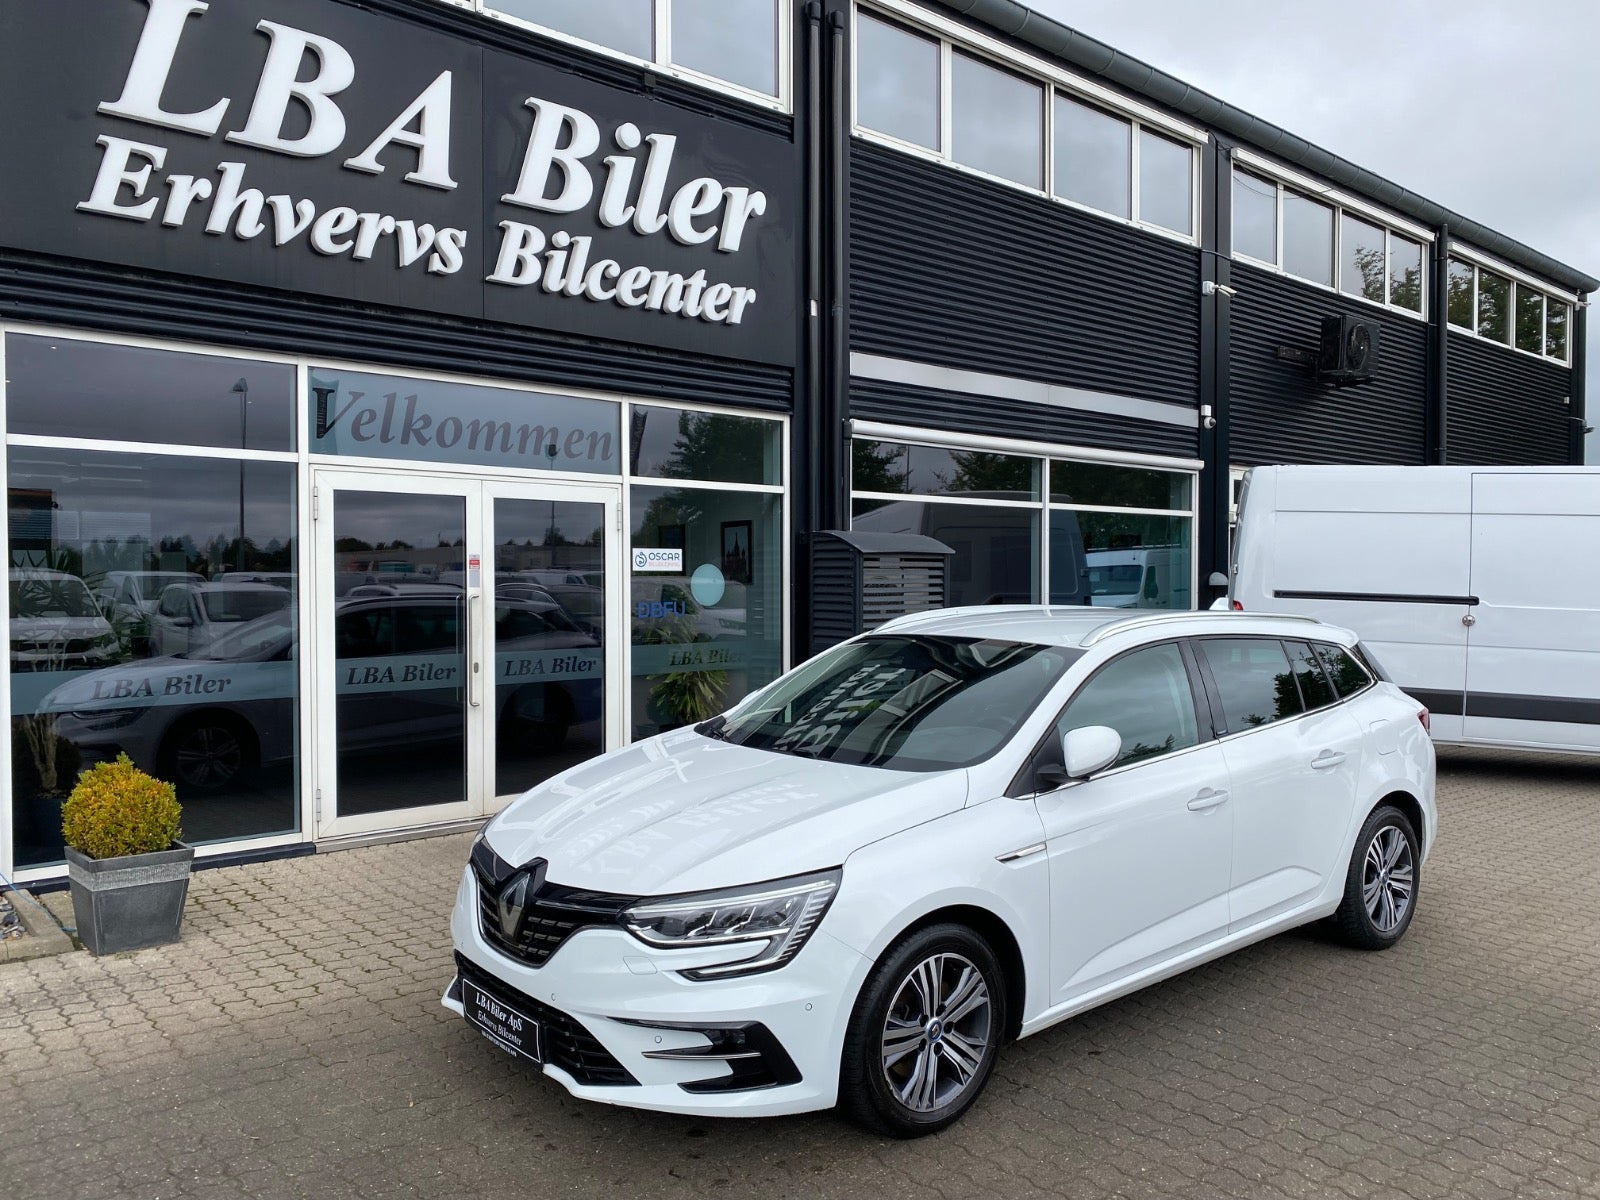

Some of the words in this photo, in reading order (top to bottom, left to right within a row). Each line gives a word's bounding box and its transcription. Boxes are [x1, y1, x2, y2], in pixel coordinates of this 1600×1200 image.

[97, 0, 458, 191] LBA
[500, 96, 767, 254] Biler
[77, 133, 468, 276] Erhvervs
[485, 219, 757, 325] Bilcenter
[311, 386, 614, 462] Velkommen
[648, 552, 680, 561] OSCAR
[504, 659, 546, 677] LBA
[550, 655, 597, 674] Biler
[669, 651, 704, 667] LBA
[90, 677, 154, 701] LBA
[163, 673, 232, 697] Biler
[346, 665, 395, 686] LBA
[401, 662, 457, 683] Biler
[476, 992, 490, 1011] LBA
[490, 1001, 507, 1022] Biler
[507, 1013, 523, 1032] ApS
[498, 1025, 522, 1046] Bilcenter
